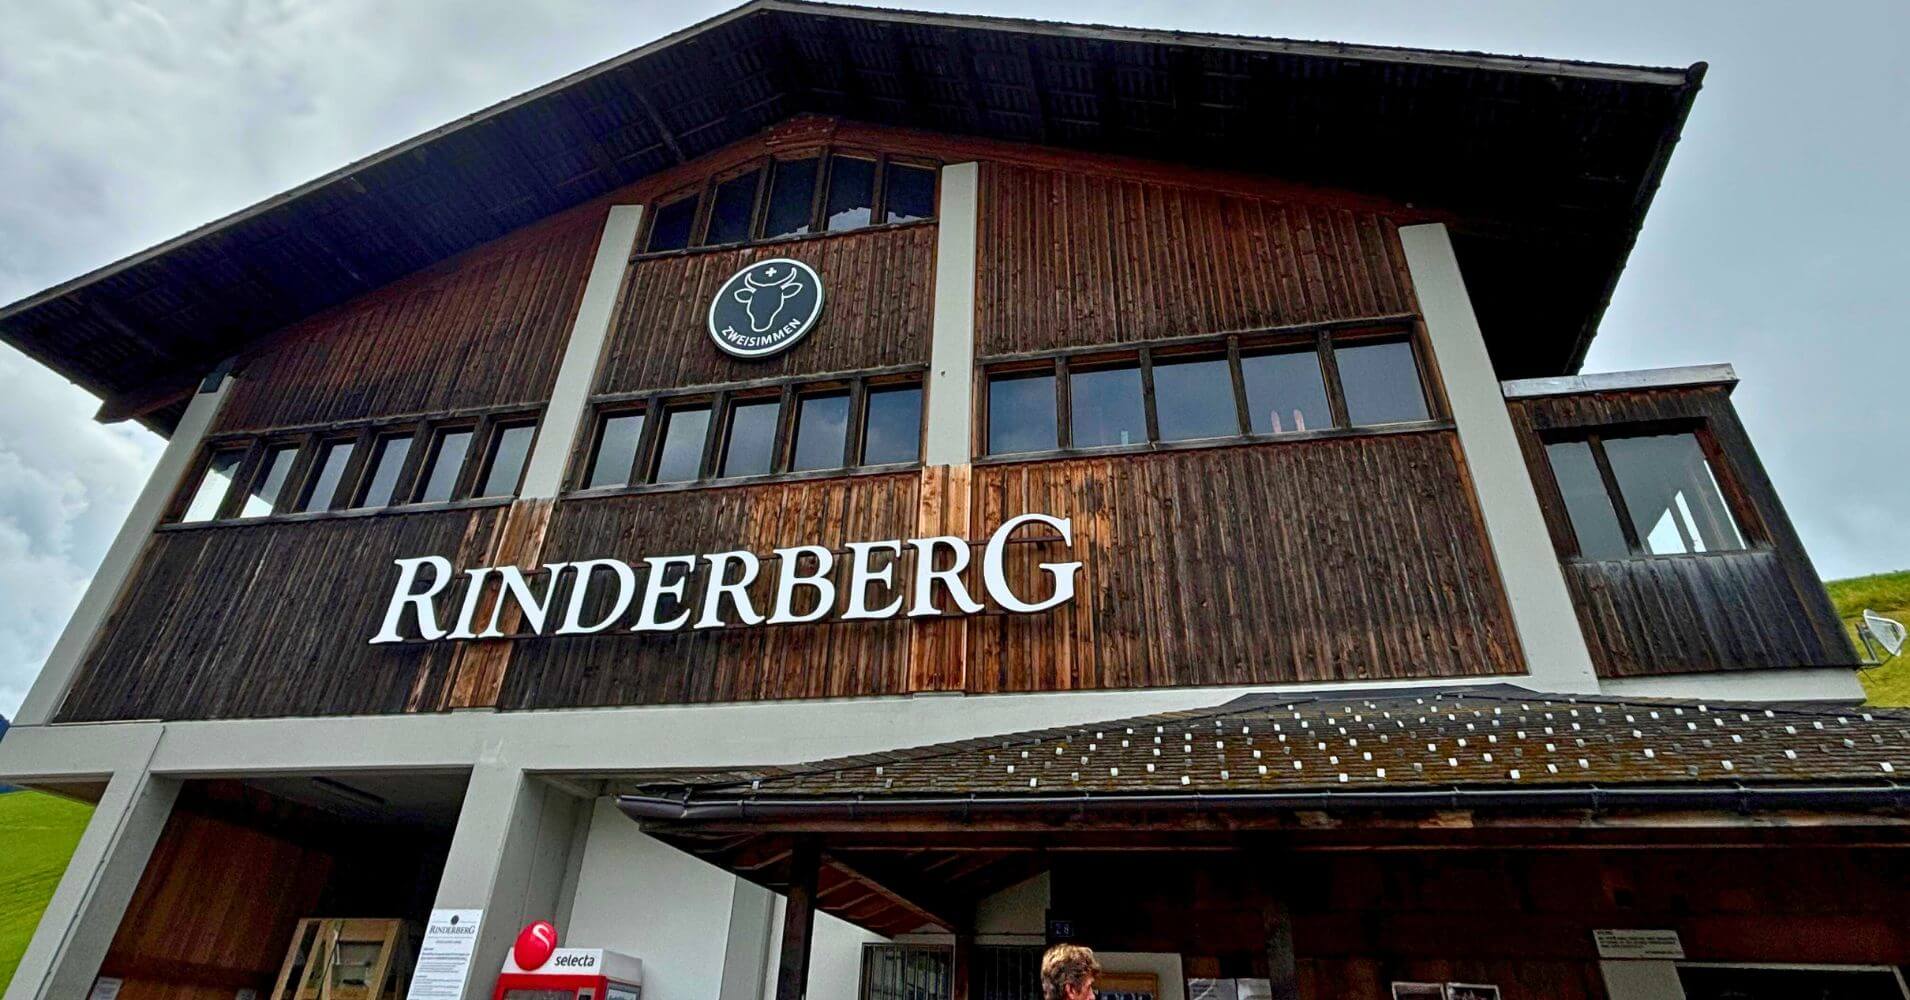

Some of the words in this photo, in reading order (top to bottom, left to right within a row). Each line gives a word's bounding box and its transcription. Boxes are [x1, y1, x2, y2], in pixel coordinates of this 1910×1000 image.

[721, 318, 801, 346] ZWEISIMMEN
[369, 513, 1083, 644] RINDERBERG
[429, 925, 475, 935] RINDERBERG
[554, 954, 595, 967] selecta
